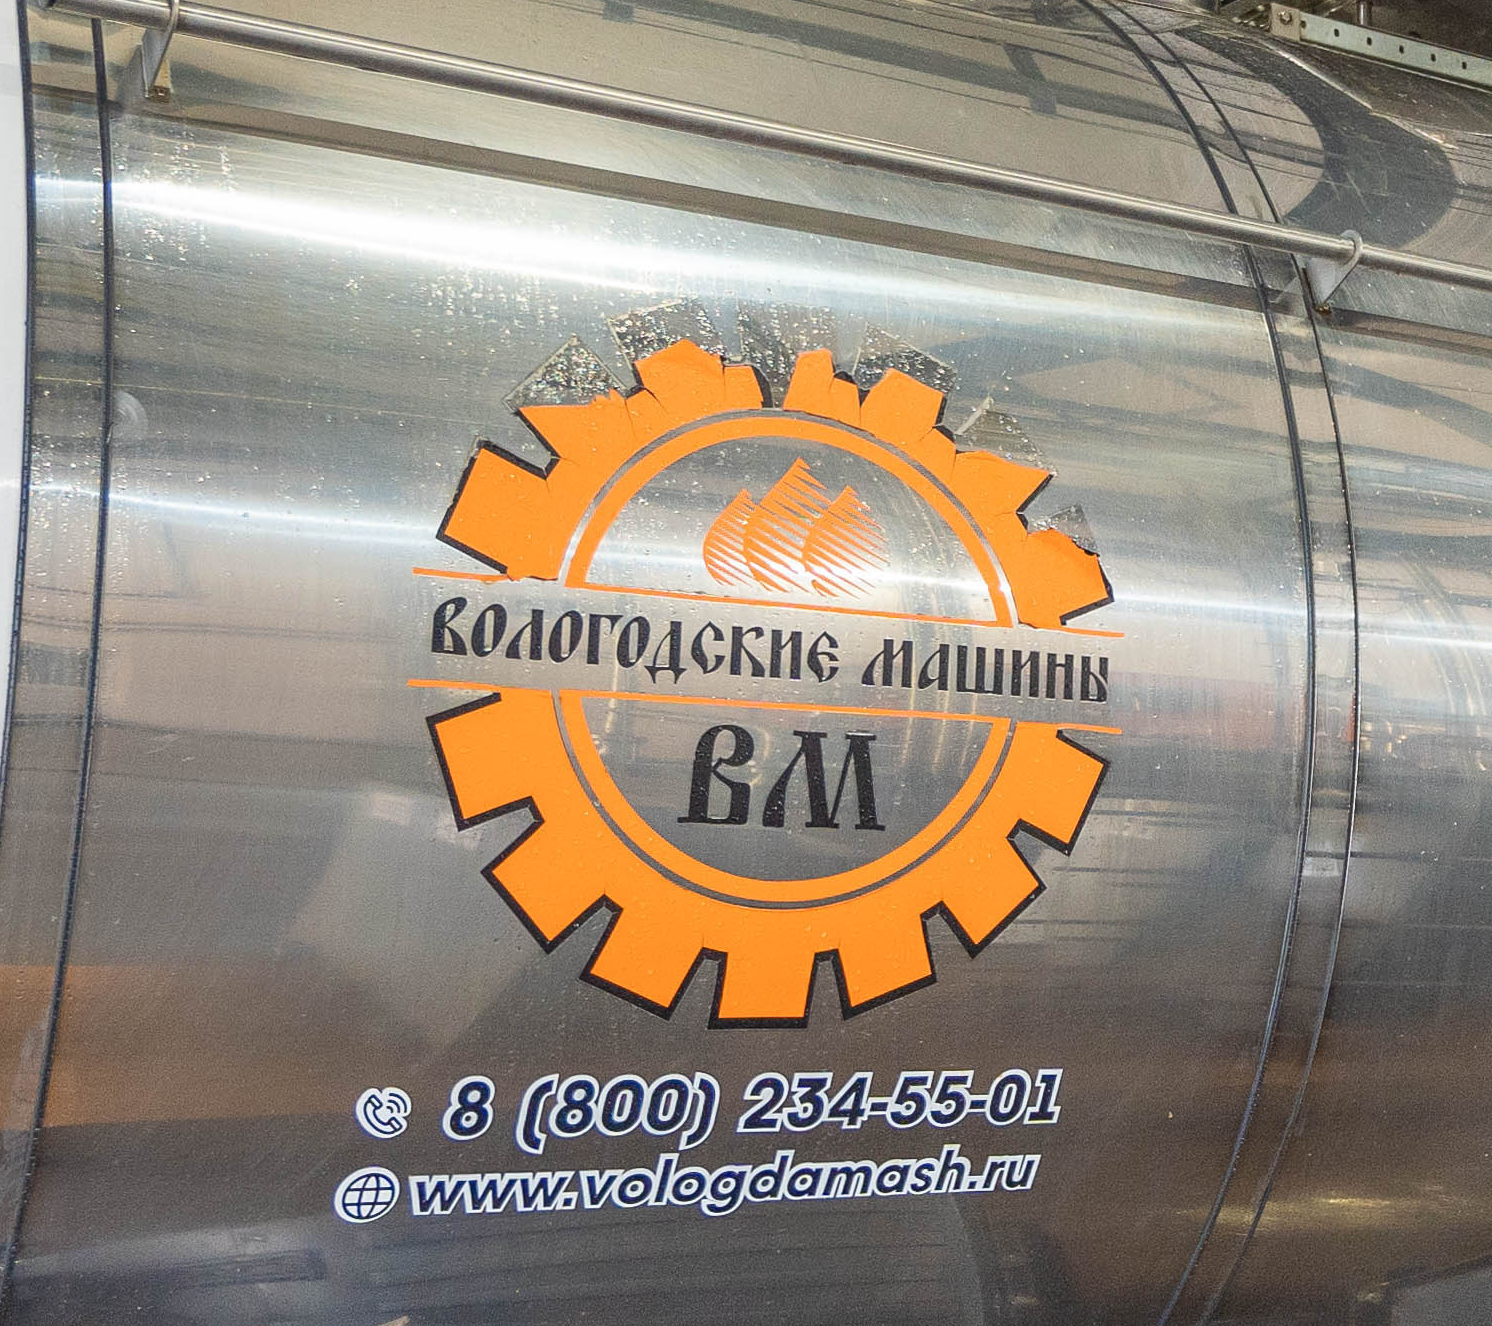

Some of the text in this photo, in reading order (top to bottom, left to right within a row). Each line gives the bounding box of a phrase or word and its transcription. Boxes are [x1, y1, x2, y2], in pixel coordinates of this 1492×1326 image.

[430, 596, 1108, 703] ВОЛОГОДСКИЕ МАШИНЫ
[676, 724, 886, 831] ВМ
[441, 1069, 1063, 1154] 8 (800) 234-55-01
[409, 1147, 1040, 1217] www.vologdamash.ru
